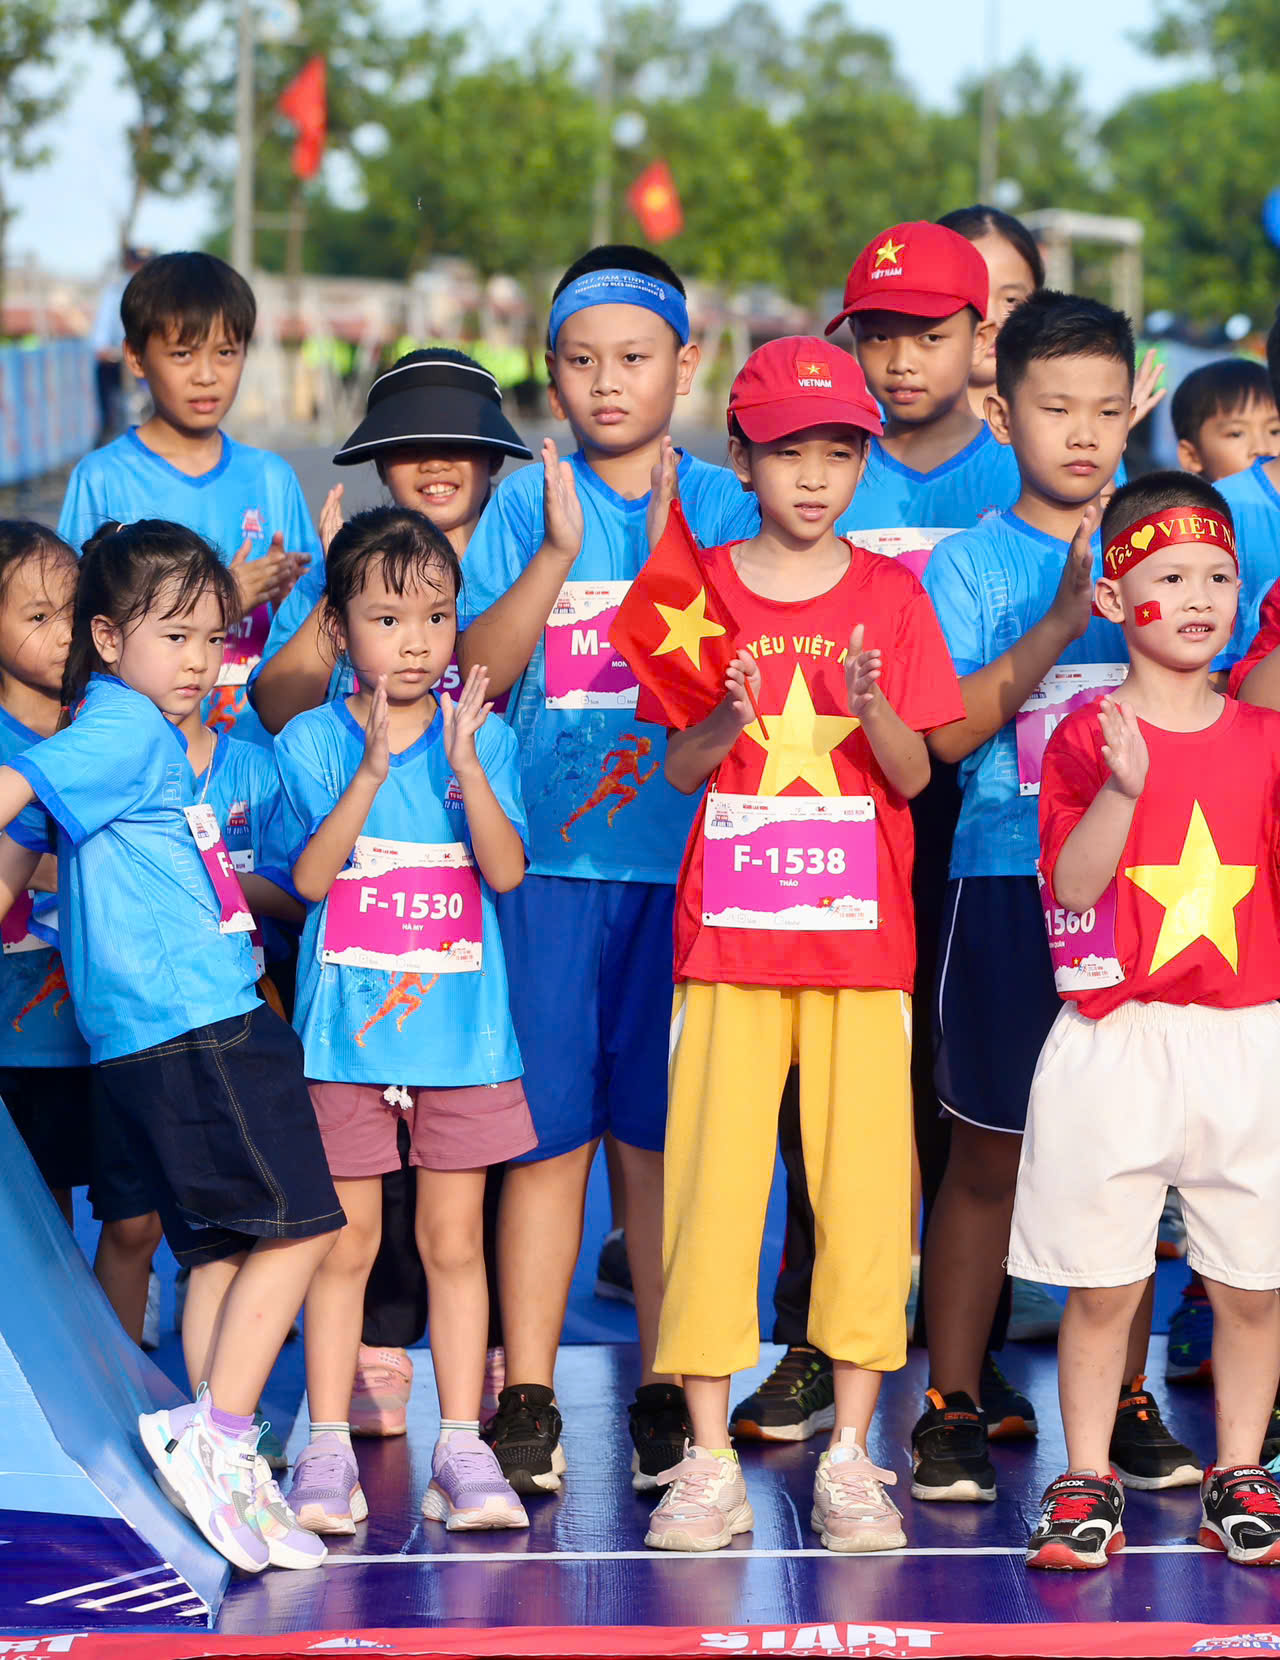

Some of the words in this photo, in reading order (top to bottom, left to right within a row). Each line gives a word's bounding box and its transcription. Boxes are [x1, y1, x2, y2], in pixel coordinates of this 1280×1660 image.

[1106, 544, 1133, 574] Tôi
[1156, 514, 1219, 539] VIỆT
[1221, 523, 1239, 561] NA
[746, 634, 785, 659] YÊU
[792, 634, 835, 660] VIỆT
[734, 845, 847, 875] F-1538
[359, 886, 464, 920] F-1530
[1053, 1480, 1085, 1490] GEOX
[1234, 1468, 1266, 1477] GEOX
